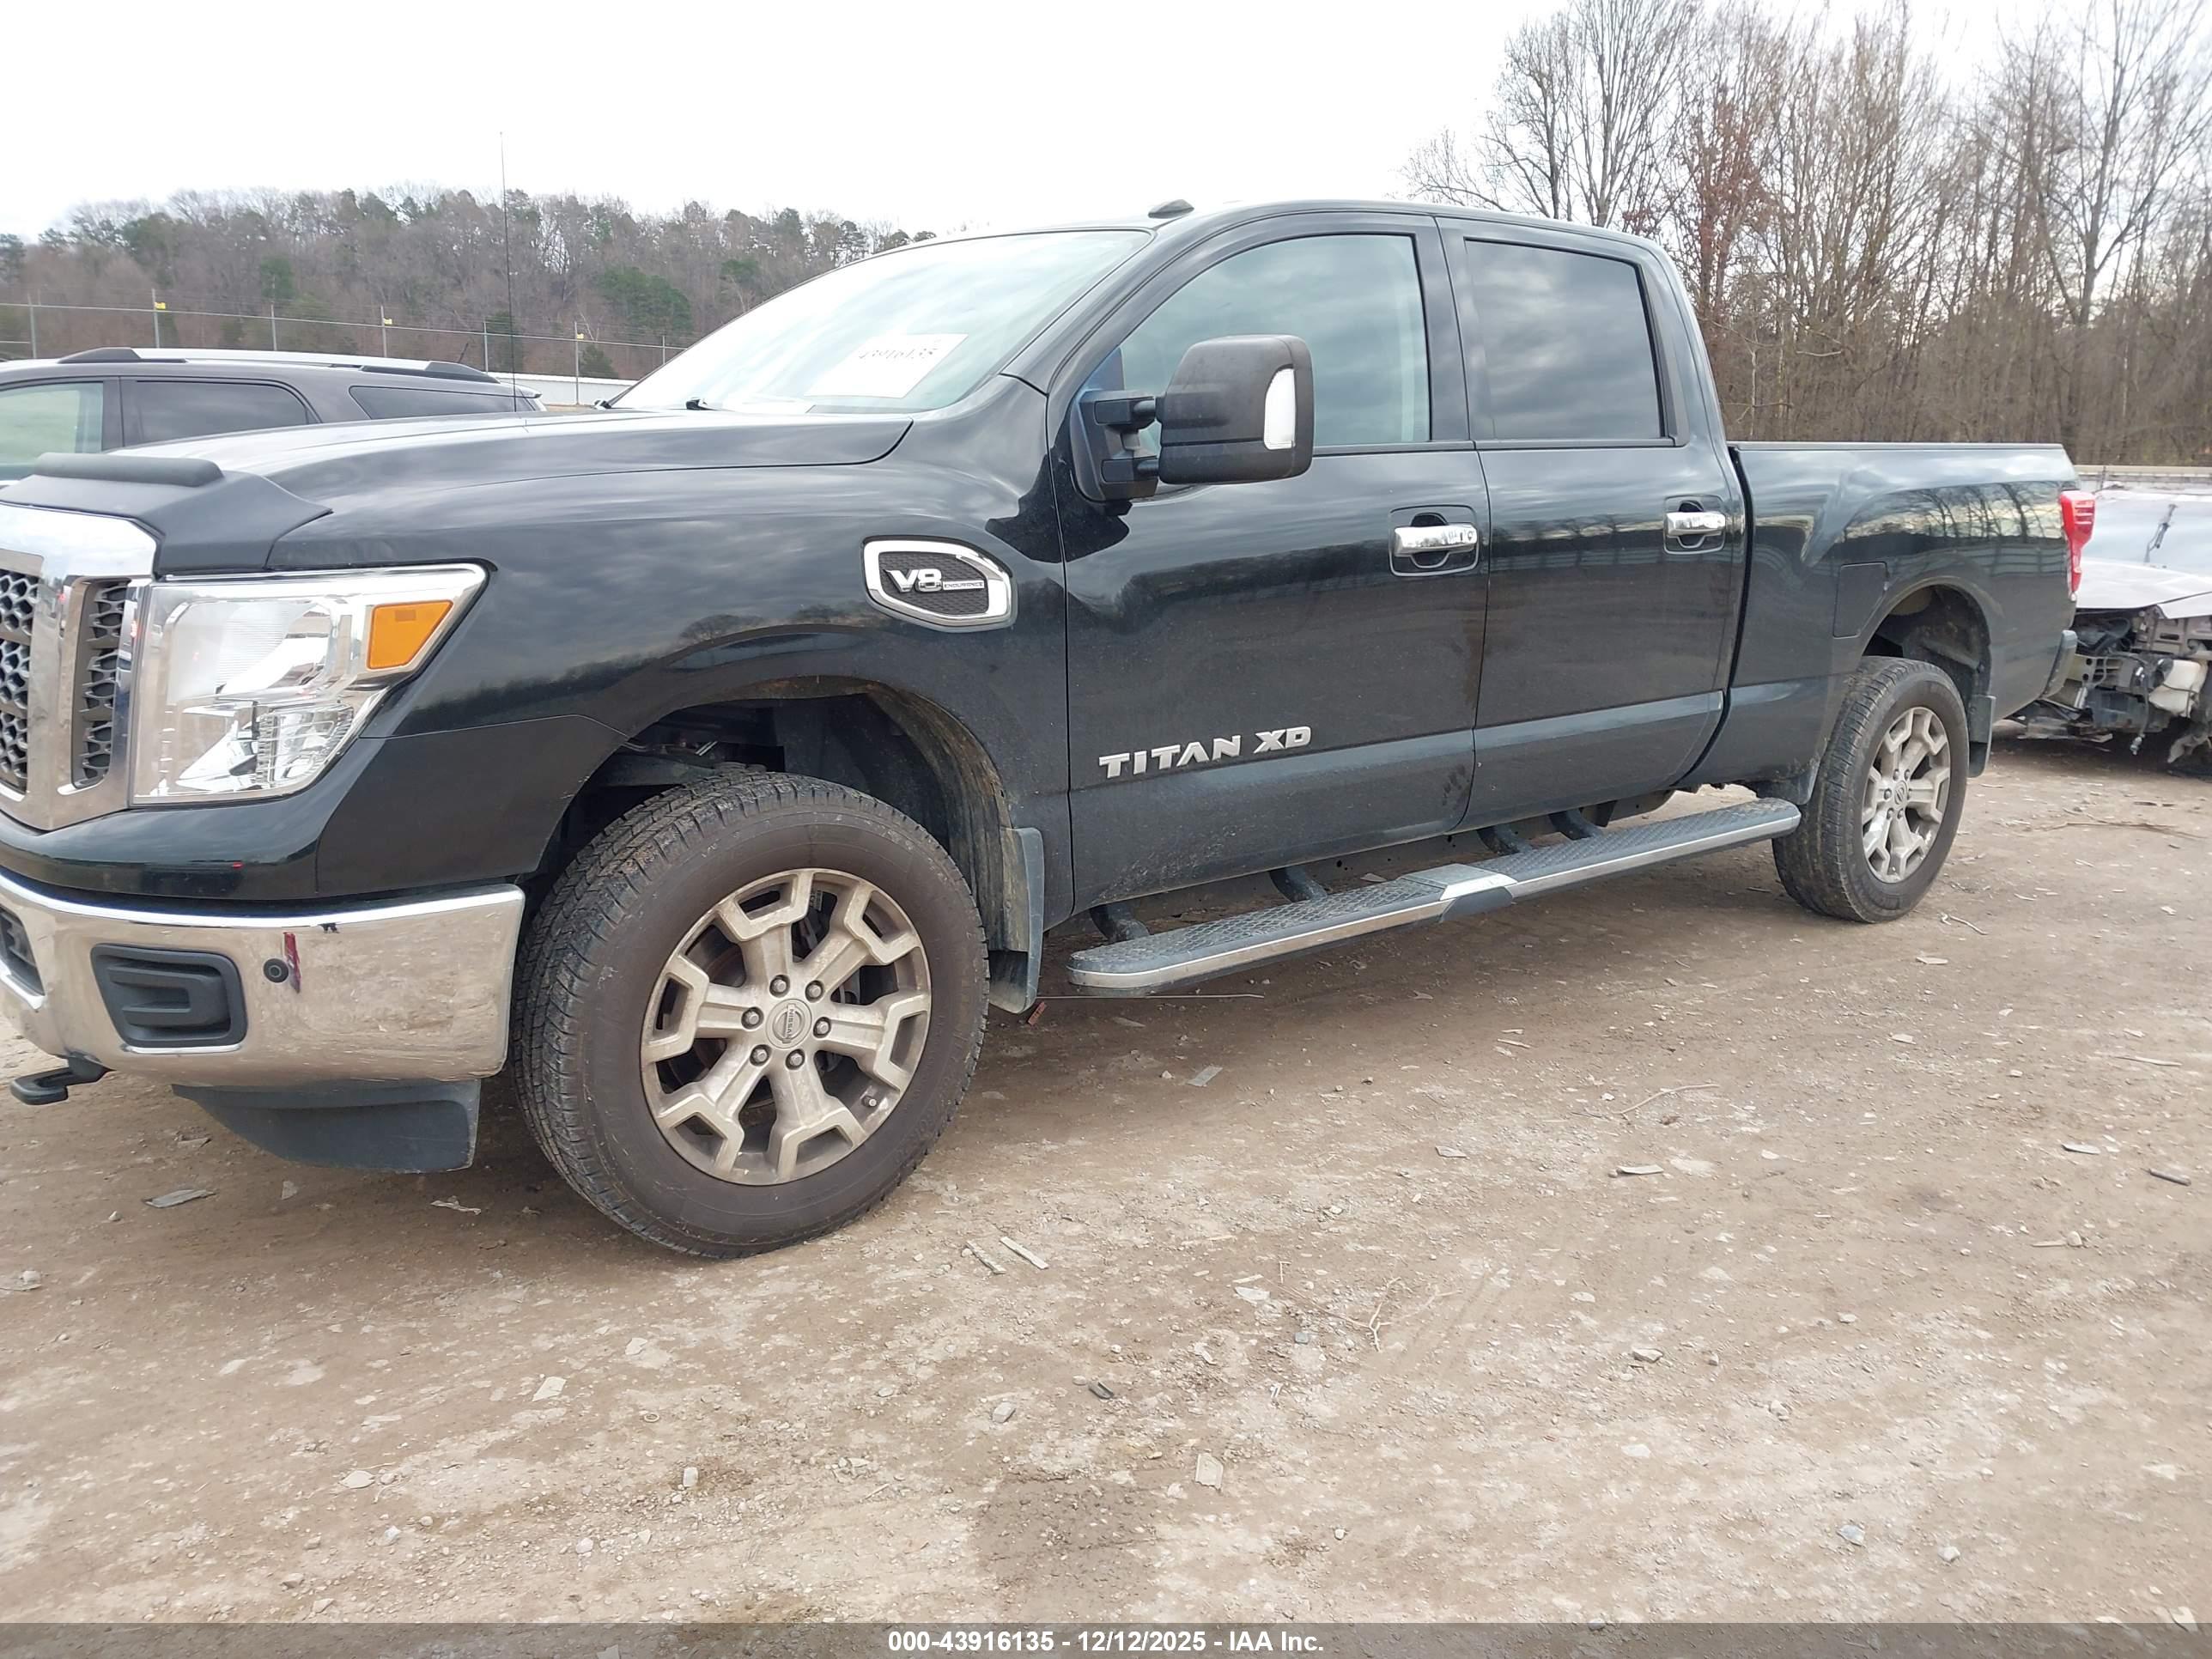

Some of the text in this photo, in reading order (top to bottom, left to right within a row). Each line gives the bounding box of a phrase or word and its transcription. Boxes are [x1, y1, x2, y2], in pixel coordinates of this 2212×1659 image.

[884, 568, 942, 592] V8
[1099, 726, 1311, 779] TITAN XD
[785, 1008, 794, 1039] NISSAN
